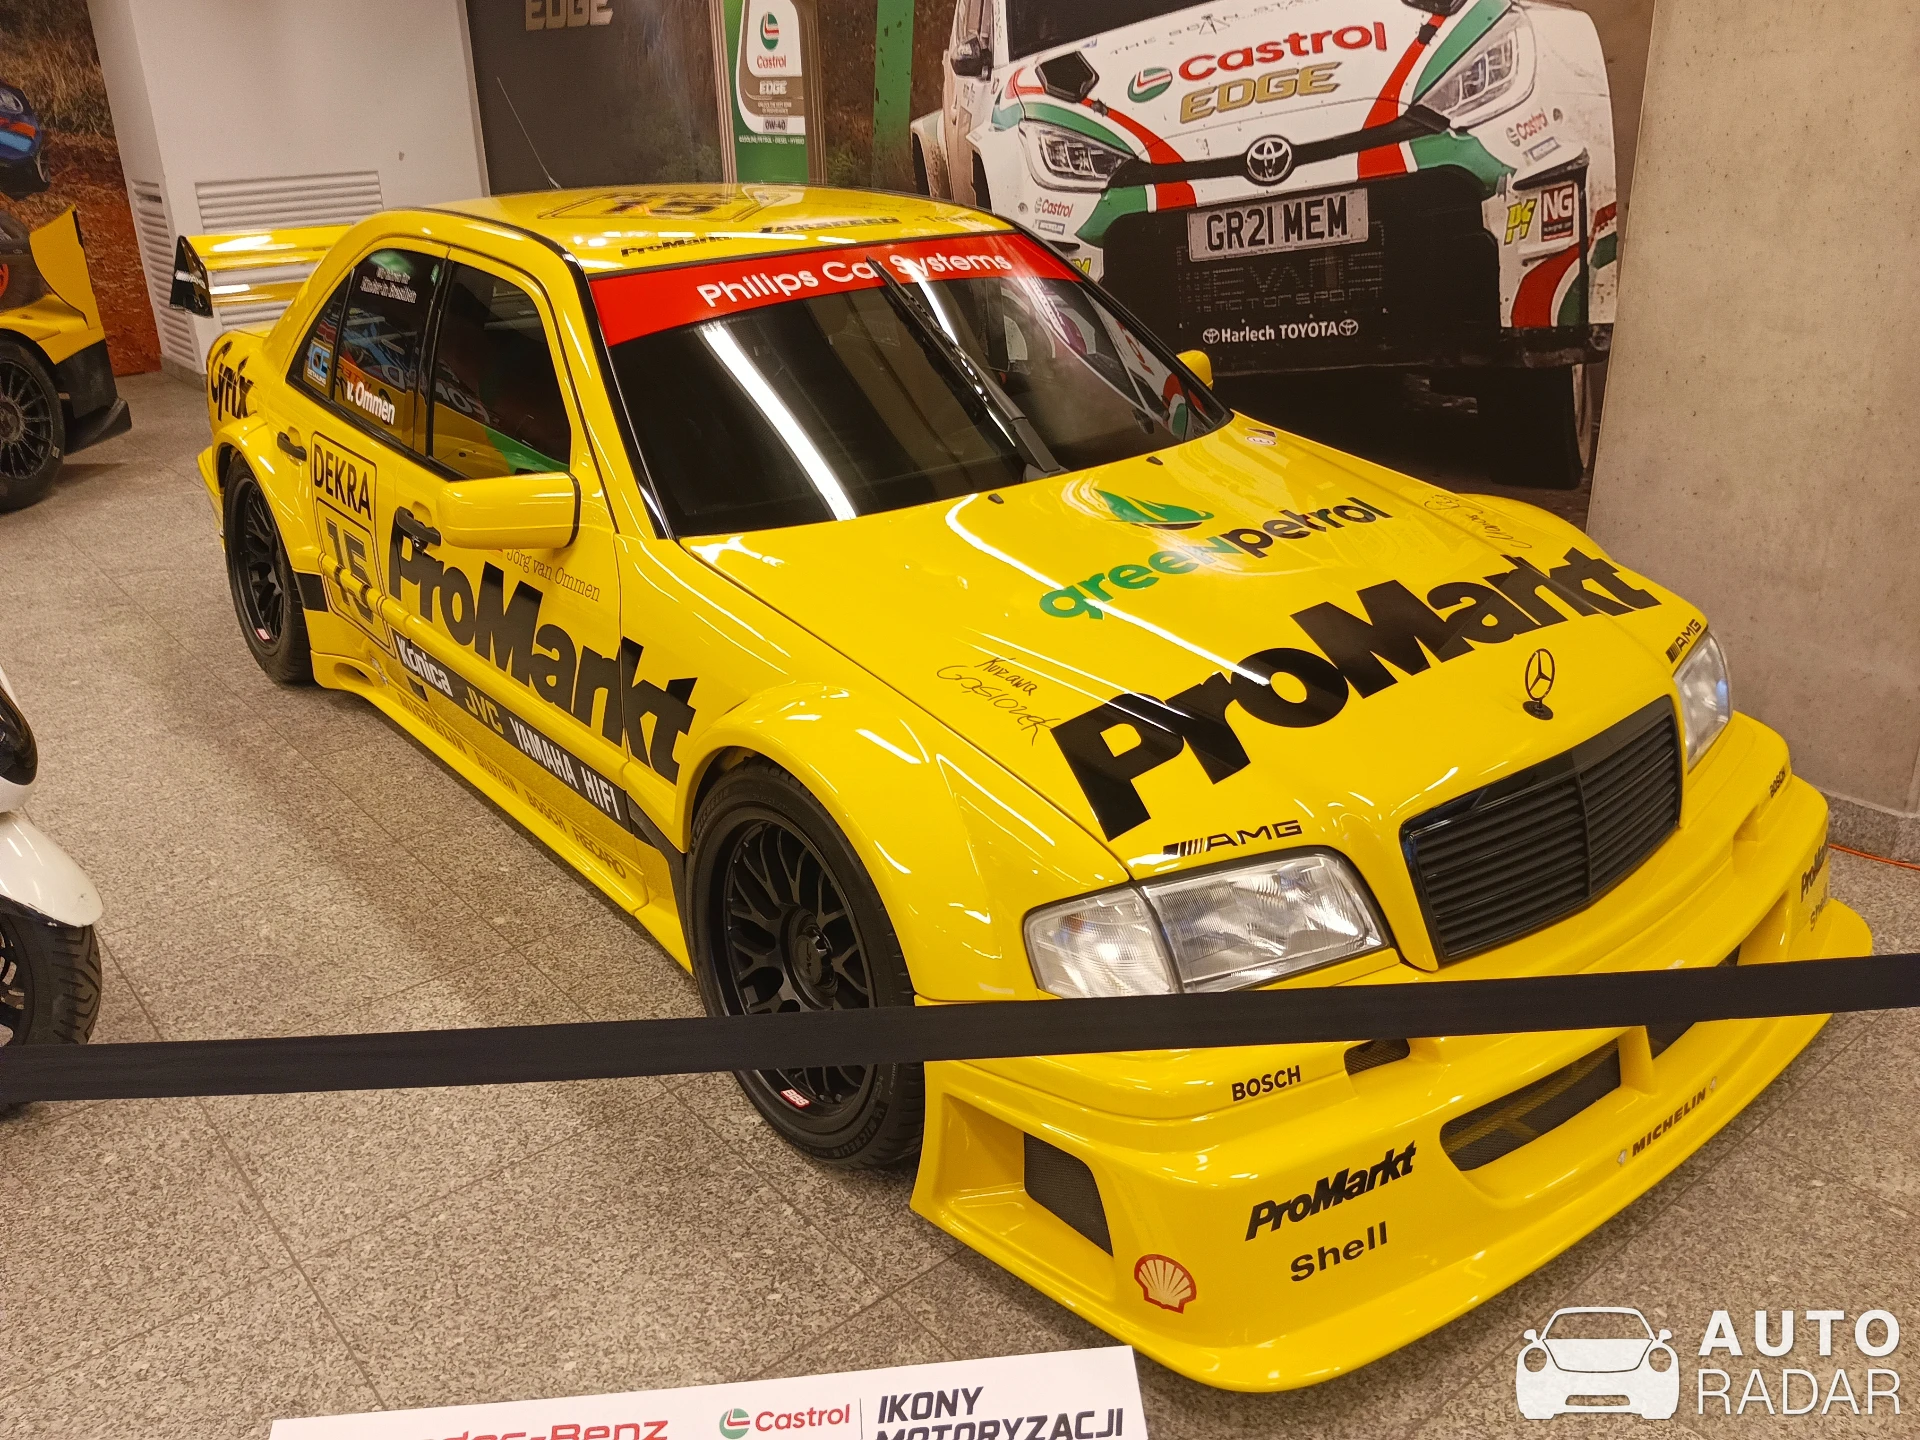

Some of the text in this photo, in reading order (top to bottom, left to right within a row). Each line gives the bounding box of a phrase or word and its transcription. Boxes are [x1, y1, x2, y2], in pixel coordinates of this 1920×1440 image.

[756, 55, 787, 69] Castrol
[1178, 21, 1387, 82] Castrol
[759, 80, 787, 95] EDGE
[1179, 61, 1343, 124] EDGE
[1042, 199, 1073, 218] Castrol
[1206, 195, 1347, 252] GR21 MEM
[1543, 187, 1574, 222] NG
[696, 268, 819, 308] Philips
[889, 252, 1013, 279] Systems
[1221, 321, 1338, 343] Harlech TOYOTA
[355, 383, 395, 425] Ommen
[314, 444, 372, 521] DEKRA
[533, 559, 553, 581] van
[554, 567, 600, 602] Ommen
[1038, 496, 1393, 621] greenpetrol
[389, 515, 698, 786] ProMarkt
[1674, 618, 1702, 652] AMG
[1049, 546, 1663, 842] ProMarkt
[395, 635, 621, 821] Konica JVC YAMAHA HIFI
[523, 789, 568, 833] BOSCH
[571, 825, 626, 879] RECARO
[1204, 819, 1302, 852] AMG
[1231, 1065, 1302, 1102] BOSCH
[1631, 1087, 1706, 1158] MICHELIN
[1244, 1140, 1417, 1242] ProMarkt
[1290, 1221, 1388, 1282] Shell
[755, 1404, 850, 1432] Castrol
[878, 1386, 984, 1424] IKONY
